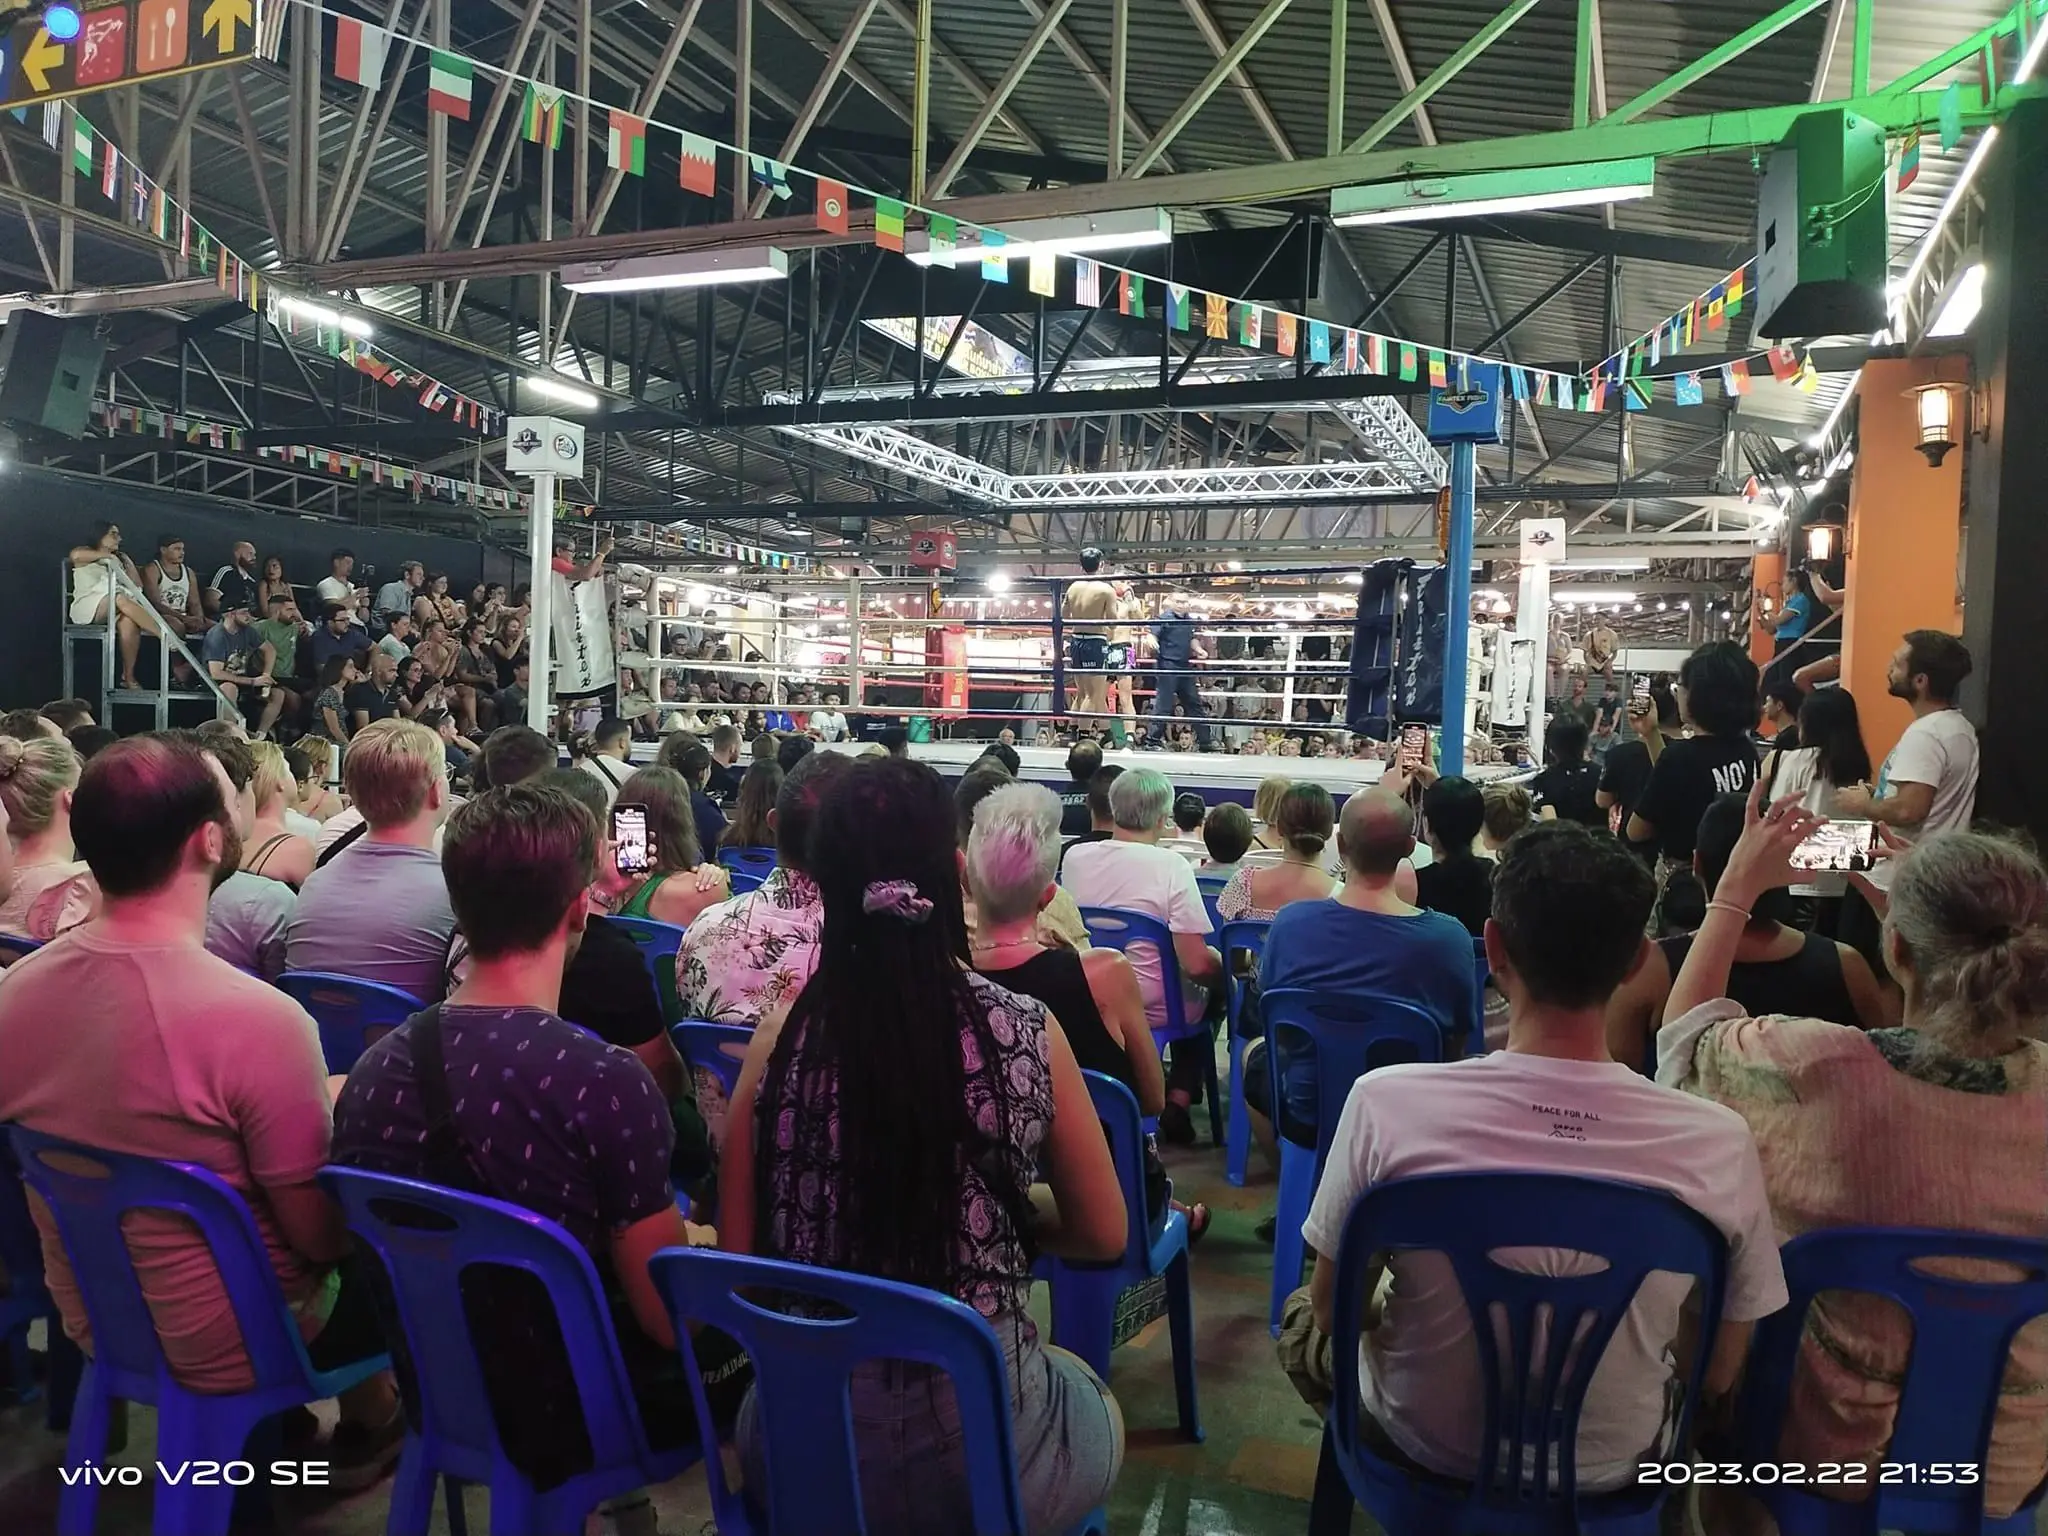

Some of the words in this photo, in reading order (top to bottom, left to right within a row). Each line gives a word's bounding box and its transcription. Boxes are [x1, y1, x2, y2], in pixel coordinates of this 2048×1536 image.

[1711, 759, 1747, 793] NO
[1532, 1104, 1561, 1116] PEACE
[1564, 1109, 1581, 1119] FOR
[1584, 1112, 1602, 1121] ALL
